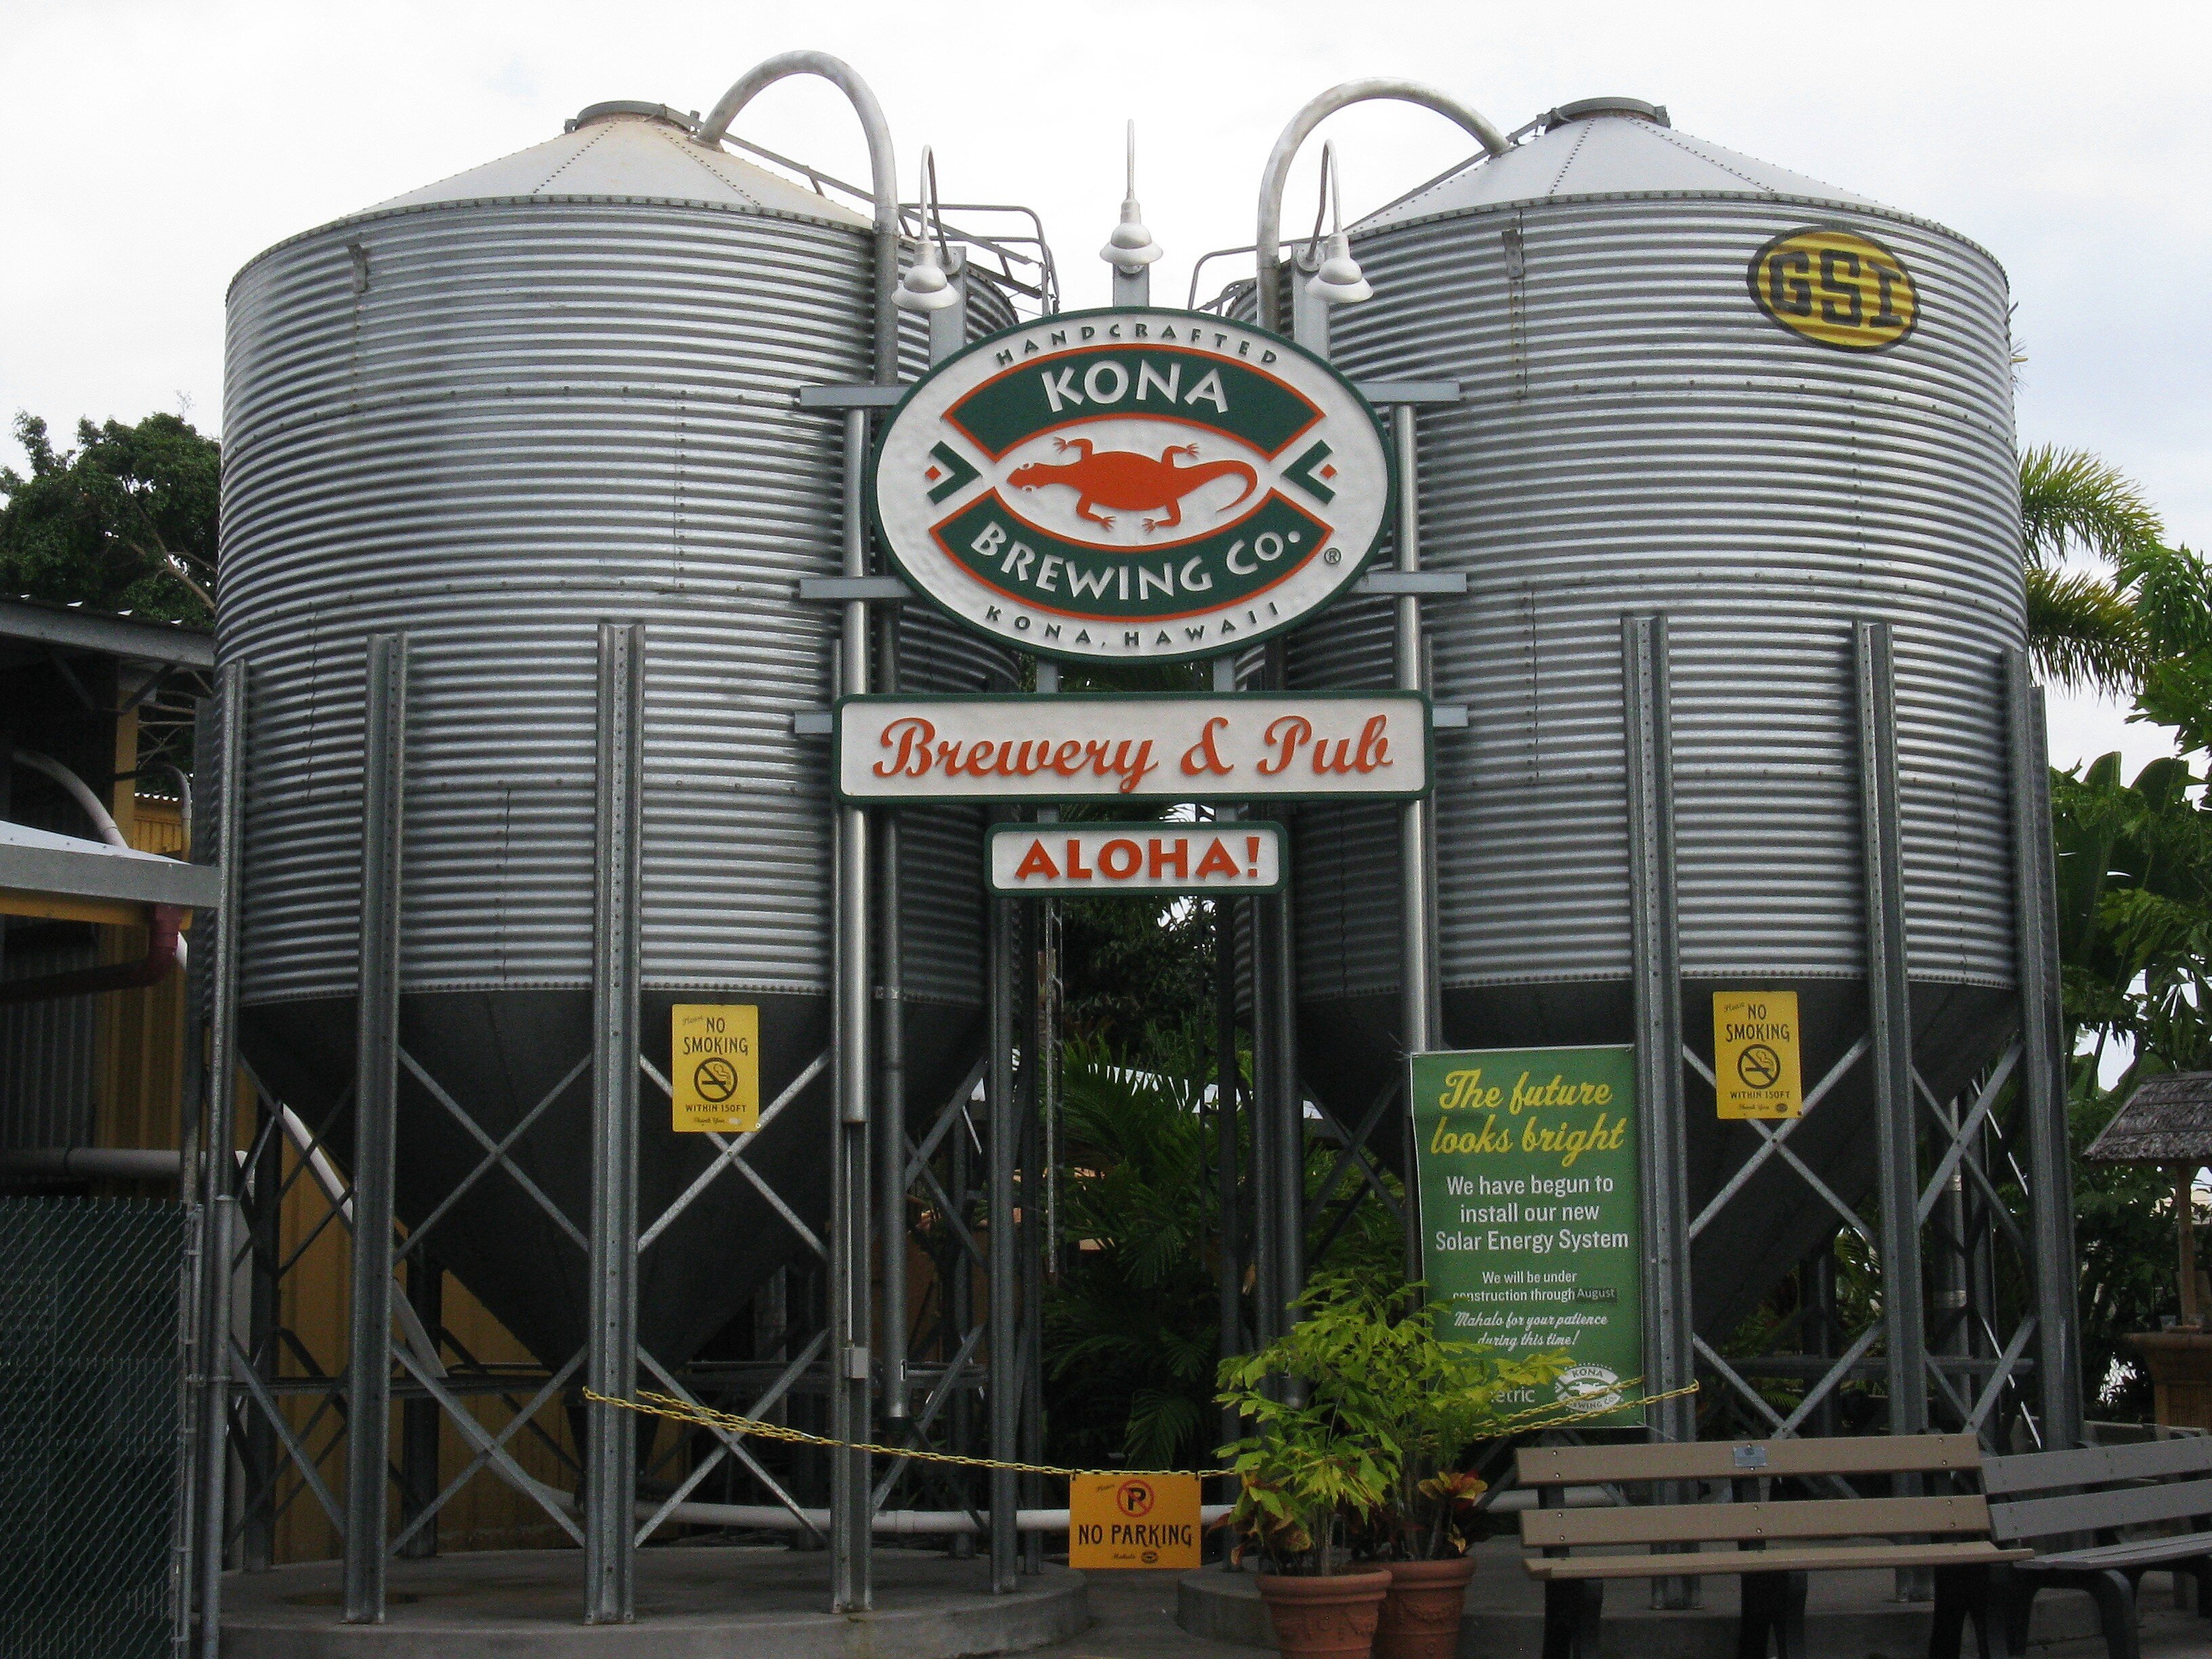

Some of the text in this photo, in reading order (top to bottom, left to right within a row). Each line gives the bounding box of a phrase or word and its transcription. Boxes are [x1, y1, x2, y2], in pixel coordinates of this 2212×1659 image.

[1769, 249, 1903, 327] GSI
[994, 323, 1277, 367] HANDCRAFTED
[1040, 359, 1229, 413] KONA
[970, 520, 1302, 602] BREWING CO.
[985, 600, 1281, 648] KONA, HAWAII
[872, 714, 1394, 794] Brewery & Pub
[1014, 836, 1261, 880] ALOHA!
[1747, 1004, 1767, 1020] NO
[706, 1017, 725, 1033] NO
[1725, 1023, 1790, 1042] SMOKING
[683, 1037, 748, 1056] SMOKING
[1439, 1068, 1614, 1115] The future
[686, 1104, 745, 1112] WITHIN 150FT
[1431, 1113, 1626, 1168] looks bright
[1446, 1174, 1614, 1197] We have begun to
[1460, 1202, 1600, 1223] install our new
[1435, 1229, 1629, 1254] Solar Energy System
[1482, 1270, 1578, 1284] We will be under
[1531, 1288, 1575, 1303] through
[1576, 1288, 1616, 1300] August
[1454, 1311, 1609, 1331] Mahalo for your patience
[1477, 1329, 1581, 1352] during this time!
[1572, 1368, 1603, 1378] KONA
[1078, 1524, 1192, 1548] NO PARKING
